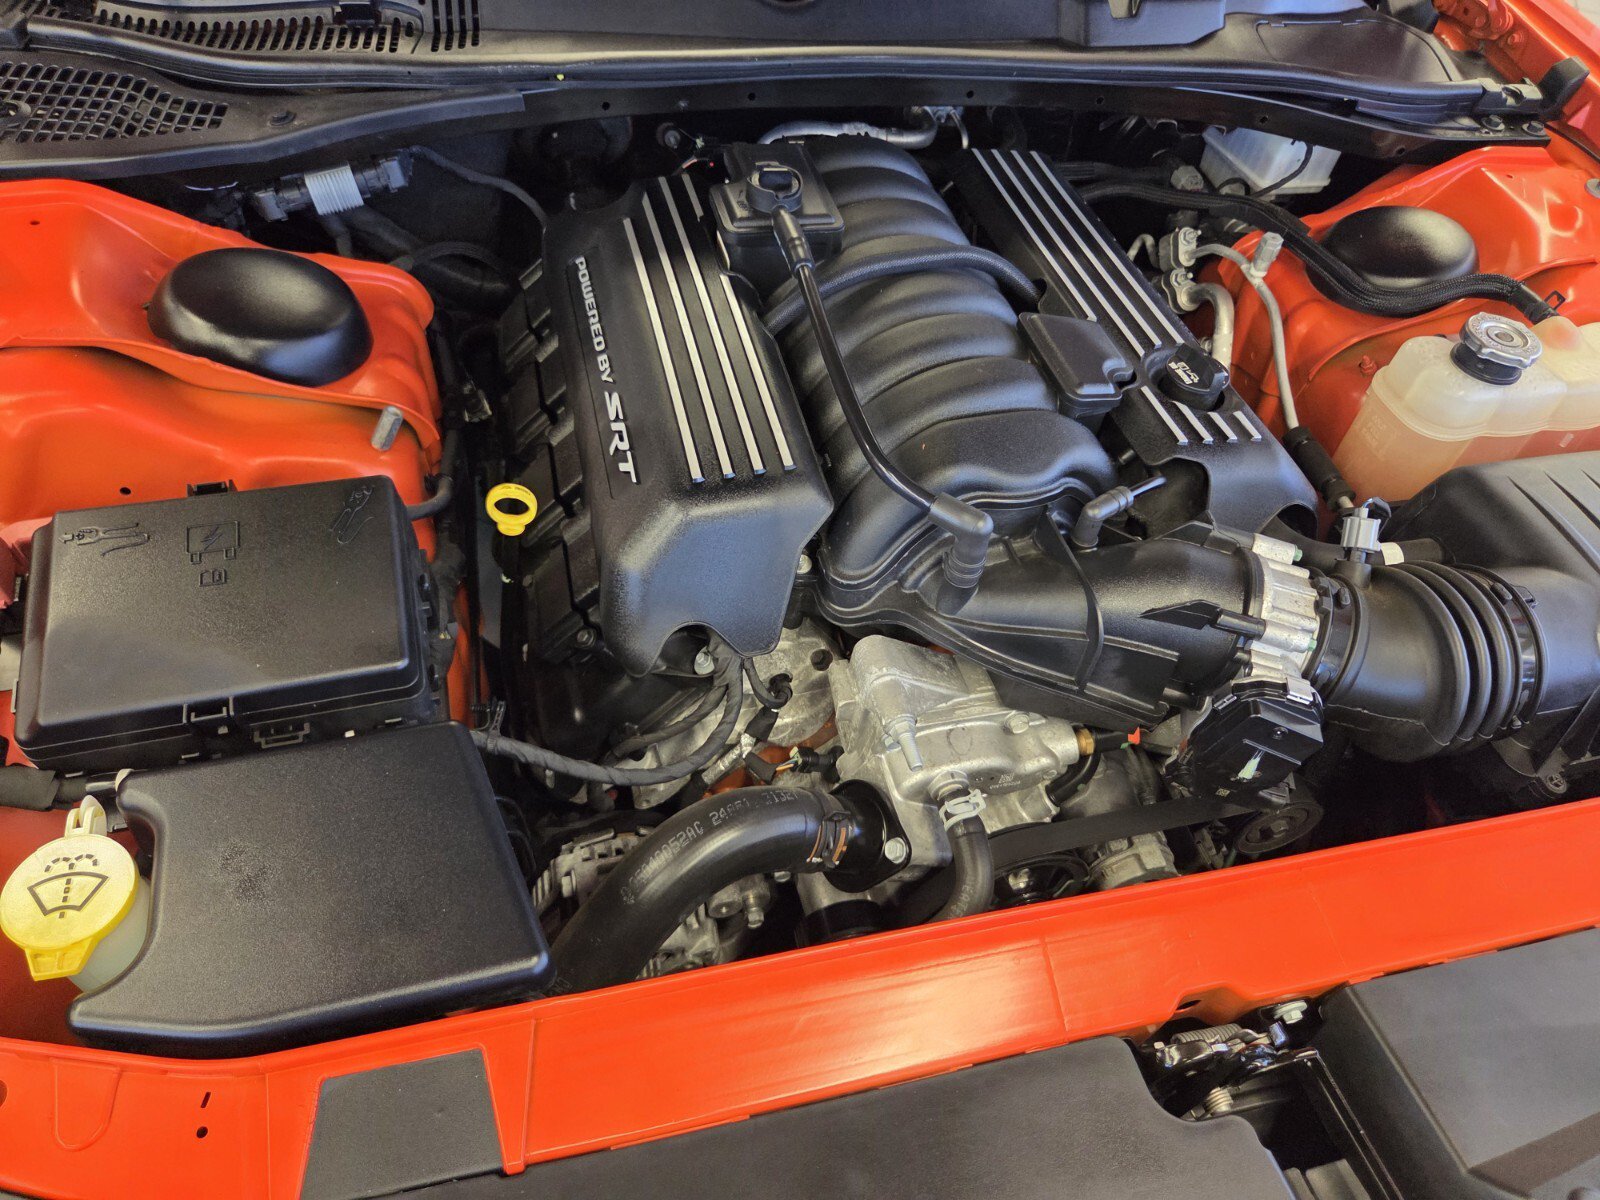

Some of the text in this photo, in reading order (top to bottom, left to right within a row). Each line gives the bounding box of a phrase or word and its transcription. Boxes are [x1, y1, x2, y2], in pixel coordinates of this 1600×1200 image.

[574, 256, 637, 484] POWERED BY SRT
